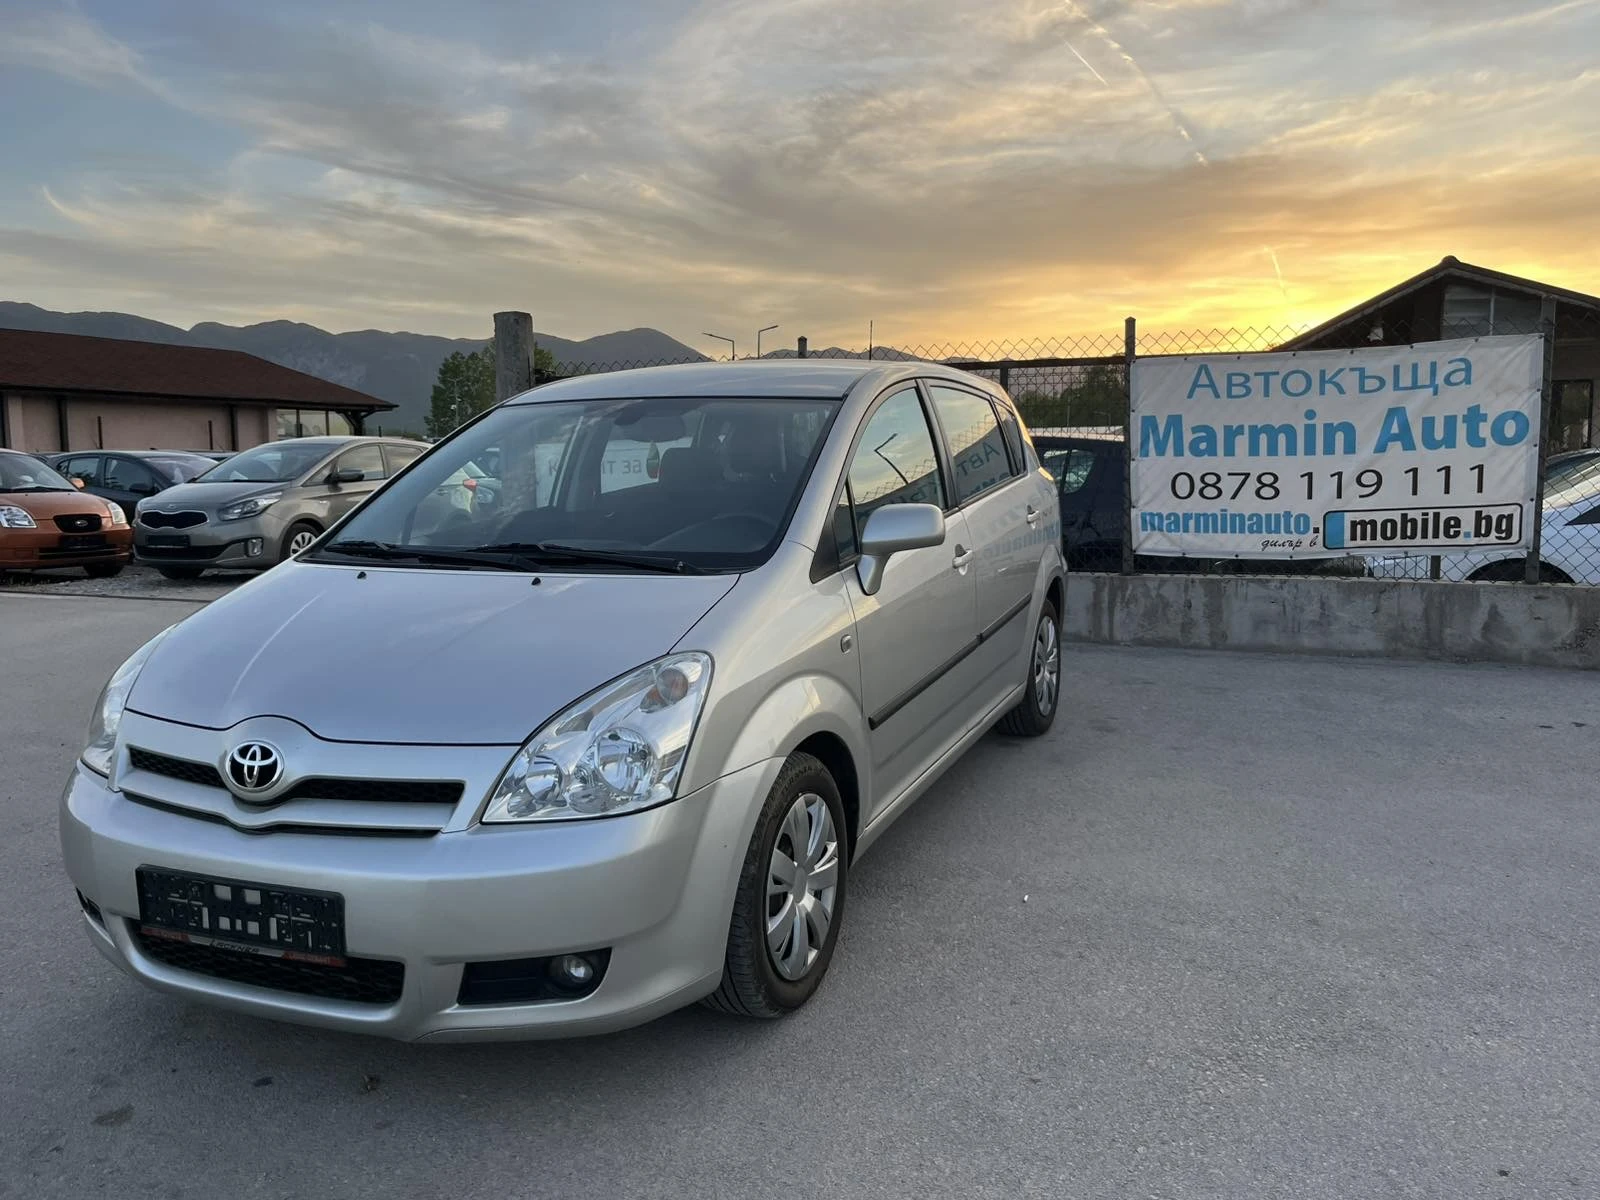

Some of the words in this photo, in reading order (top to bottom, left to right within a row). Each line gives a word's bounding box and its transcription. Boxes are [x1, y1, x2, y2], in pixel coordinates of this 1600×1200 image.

[1186, 356, 1472, 400] Автокъща
[1139, 409, 1357, 458] Marmin
[1373, 403, 1530, 454] Auto
[1170, 471, 1281, 501] 0878
[1300, 468, 1384, 501] 119
[1404, 463, 1484, 496] 111
[1349, 509, 1514, 543] mobile.bg
